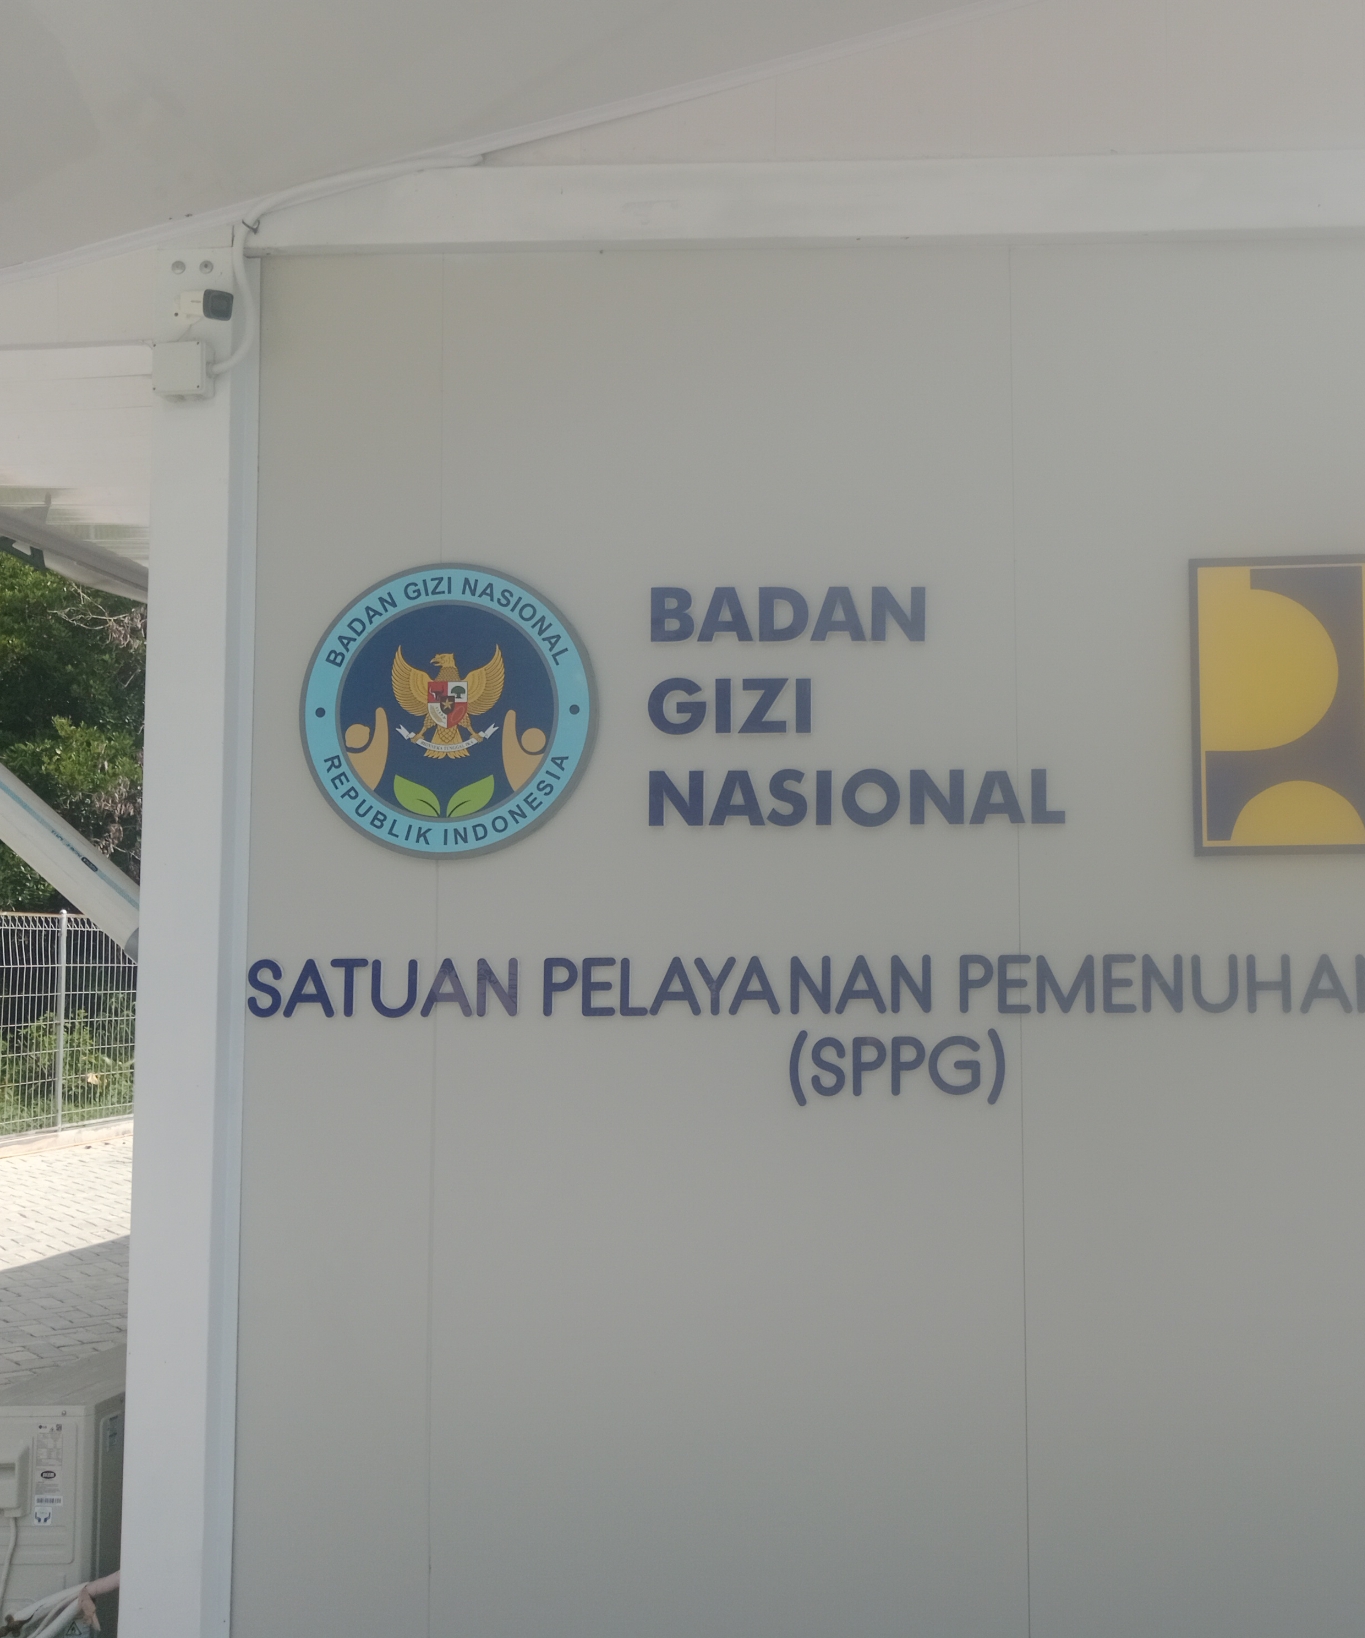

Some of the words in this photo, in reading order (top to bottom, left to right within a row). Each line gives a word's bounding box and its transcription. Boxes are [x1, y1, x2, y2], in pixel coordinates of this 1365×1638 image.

[325, 591, 398, 668] BADAN
[403, 576, 452, 601] GIZI
[461, 577, 570, 666] NASIONAL
[649, 586, 926, 644] BADAN
[647, 677, 813, 735] GIZI
[323, 754, 433, 845] REPUBLIK
[443, 753, 569, 846] INDONESIA
[647, 767, 1066, 828] NASIONAL
[246, 957, 519, 1019] SATUAN
[542, 954, 931, 1018] PELAYANAN
[789, 1029, 1007, 1107] (SPPG)
